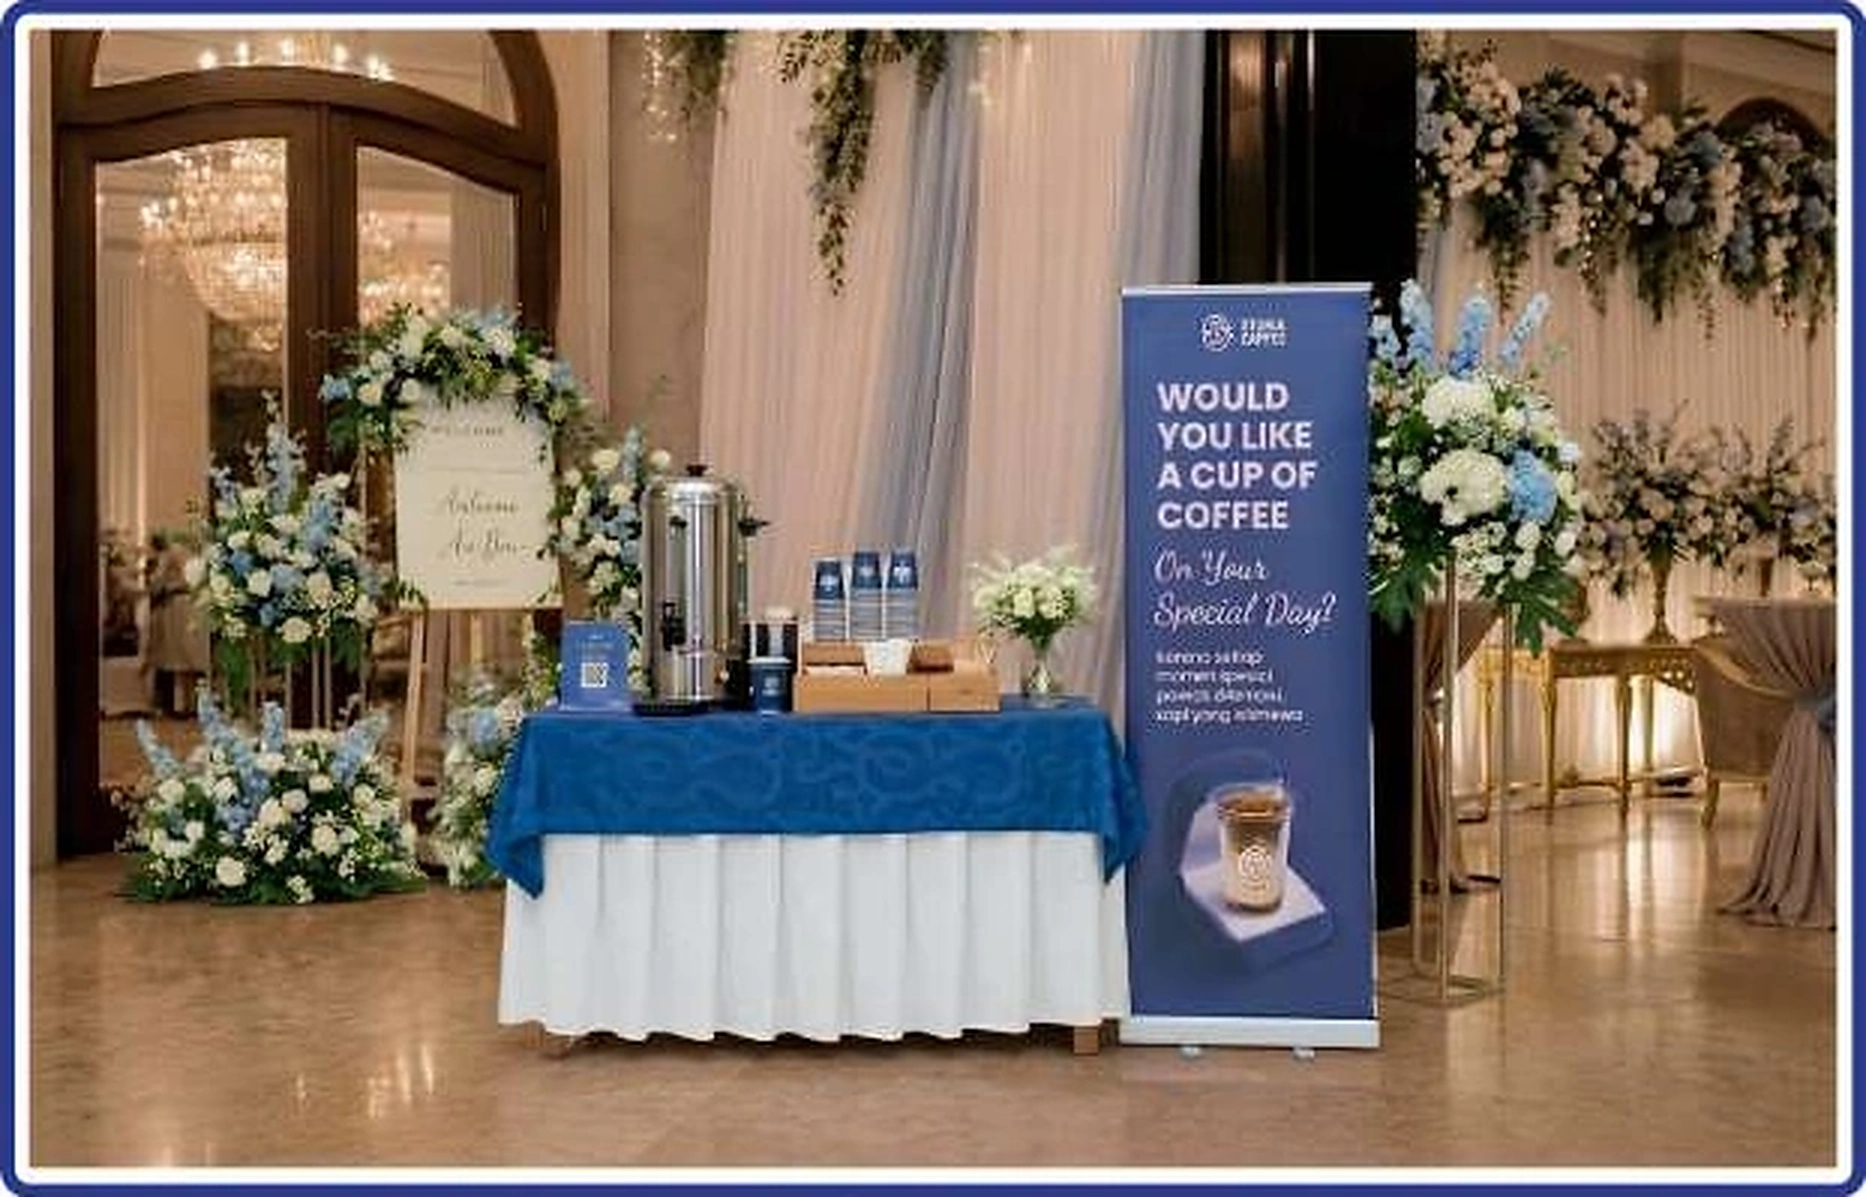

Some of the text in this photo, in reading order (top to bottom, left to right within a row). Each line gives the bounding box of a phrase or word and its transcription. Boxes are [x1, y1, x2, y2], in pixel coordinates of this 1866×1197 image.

[1157, 382, 1290, 412] WOULD
[1157, 421, 1314, 450] YOU LIKE
[1157, 461, 1317, 489] A CUP OF
[1157, 501, 1290, 530] COFFEE
[1154, 550, 1268, 586] On Your
[1154, 591, 1336, 634] Special Day?
